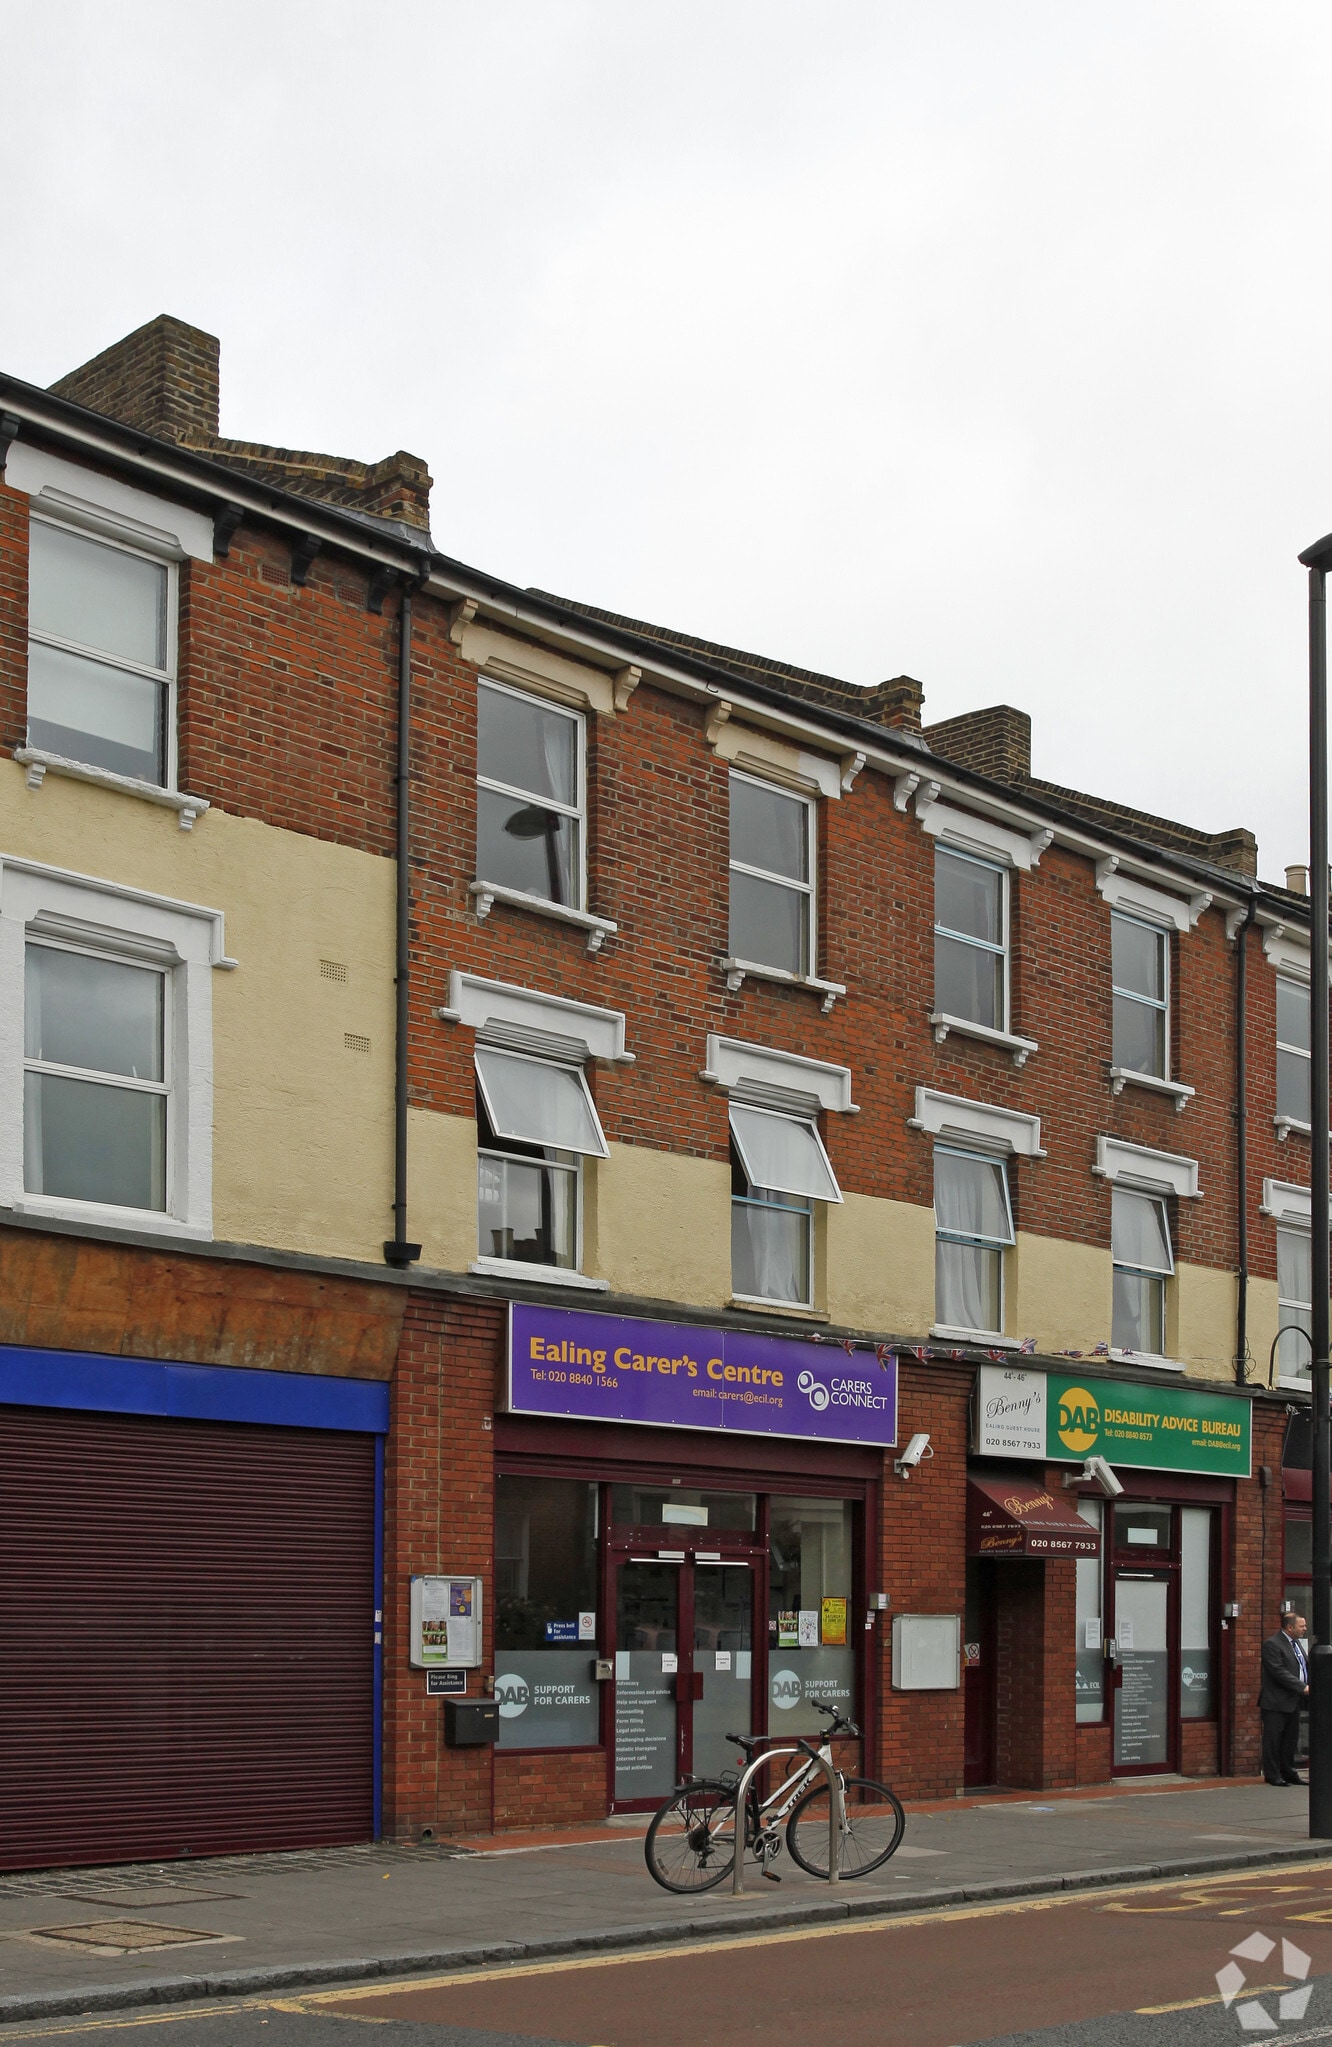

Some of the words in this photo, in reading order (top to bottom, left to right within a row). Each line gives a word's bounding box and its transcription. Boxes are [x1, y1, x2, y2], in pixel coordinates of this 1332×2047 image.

[530, 1336, 607, 1373] Ealing
[613, 1347, 698, 1378] Carer's
[706, 1358, 784, 1387] Centre
[530, 1368, 547, 1381] Tel:
[548, 1370, 566, 1383] 020
[569, 1372, 593, 1386] 8840
[596, 1375, 618, 1388] 1566
[830, 1378, 872, 1394] CARERS
[692, 1387, 717, 1399] email:
[718, 1390, 784, 1408] carers@ecil.org
[830, 1391, 888, 1410] CONNECT
[986, 1391, 1042, 1419] Benny's
[985, 1423, 1005, 1431] EALING
[1058, 1404, 1100, 1436] DAB
[1104, 1408, 1160, 1428] DISABILITY
[1161, 1416, 1198, 1432] ADVICE
[1201, 1420, 1241, 1437] BUREAU
[1104, 1428, 1114, 1437] Tel:
[1114, 1429, 1125, 1438] 020
[1125, 1431, 1139, 1440] 8840
[986, 1438, 1000, 1447] 020
[1002, 1439, 1021, 1448] 8567
[1023, 1441, 1041, 1450] 7933
[981, 1531, 1023, 1549] Benny's
[1031, 1539, 1048, 1548] 020
[1050, 1540, 1073, 1549] 8567
[1075, 1541, 1097, 1551] 7933
[805, 1679, 839, 1689] SUPPORT
[1182, 1672, 1209, 1681] mencap
[495, 1686, 529, 1706] DAB
[533, 1685, 576, 1695] SUPPORT
[771, 1680, 801, 1699] DAB
[804, 1690, 820, 1698] FOR
[821, 1689, 850, 1698] CARERS
[533, 1696, 553, 1706] FOR
[554, 1695, 591, 1705] CARERS
